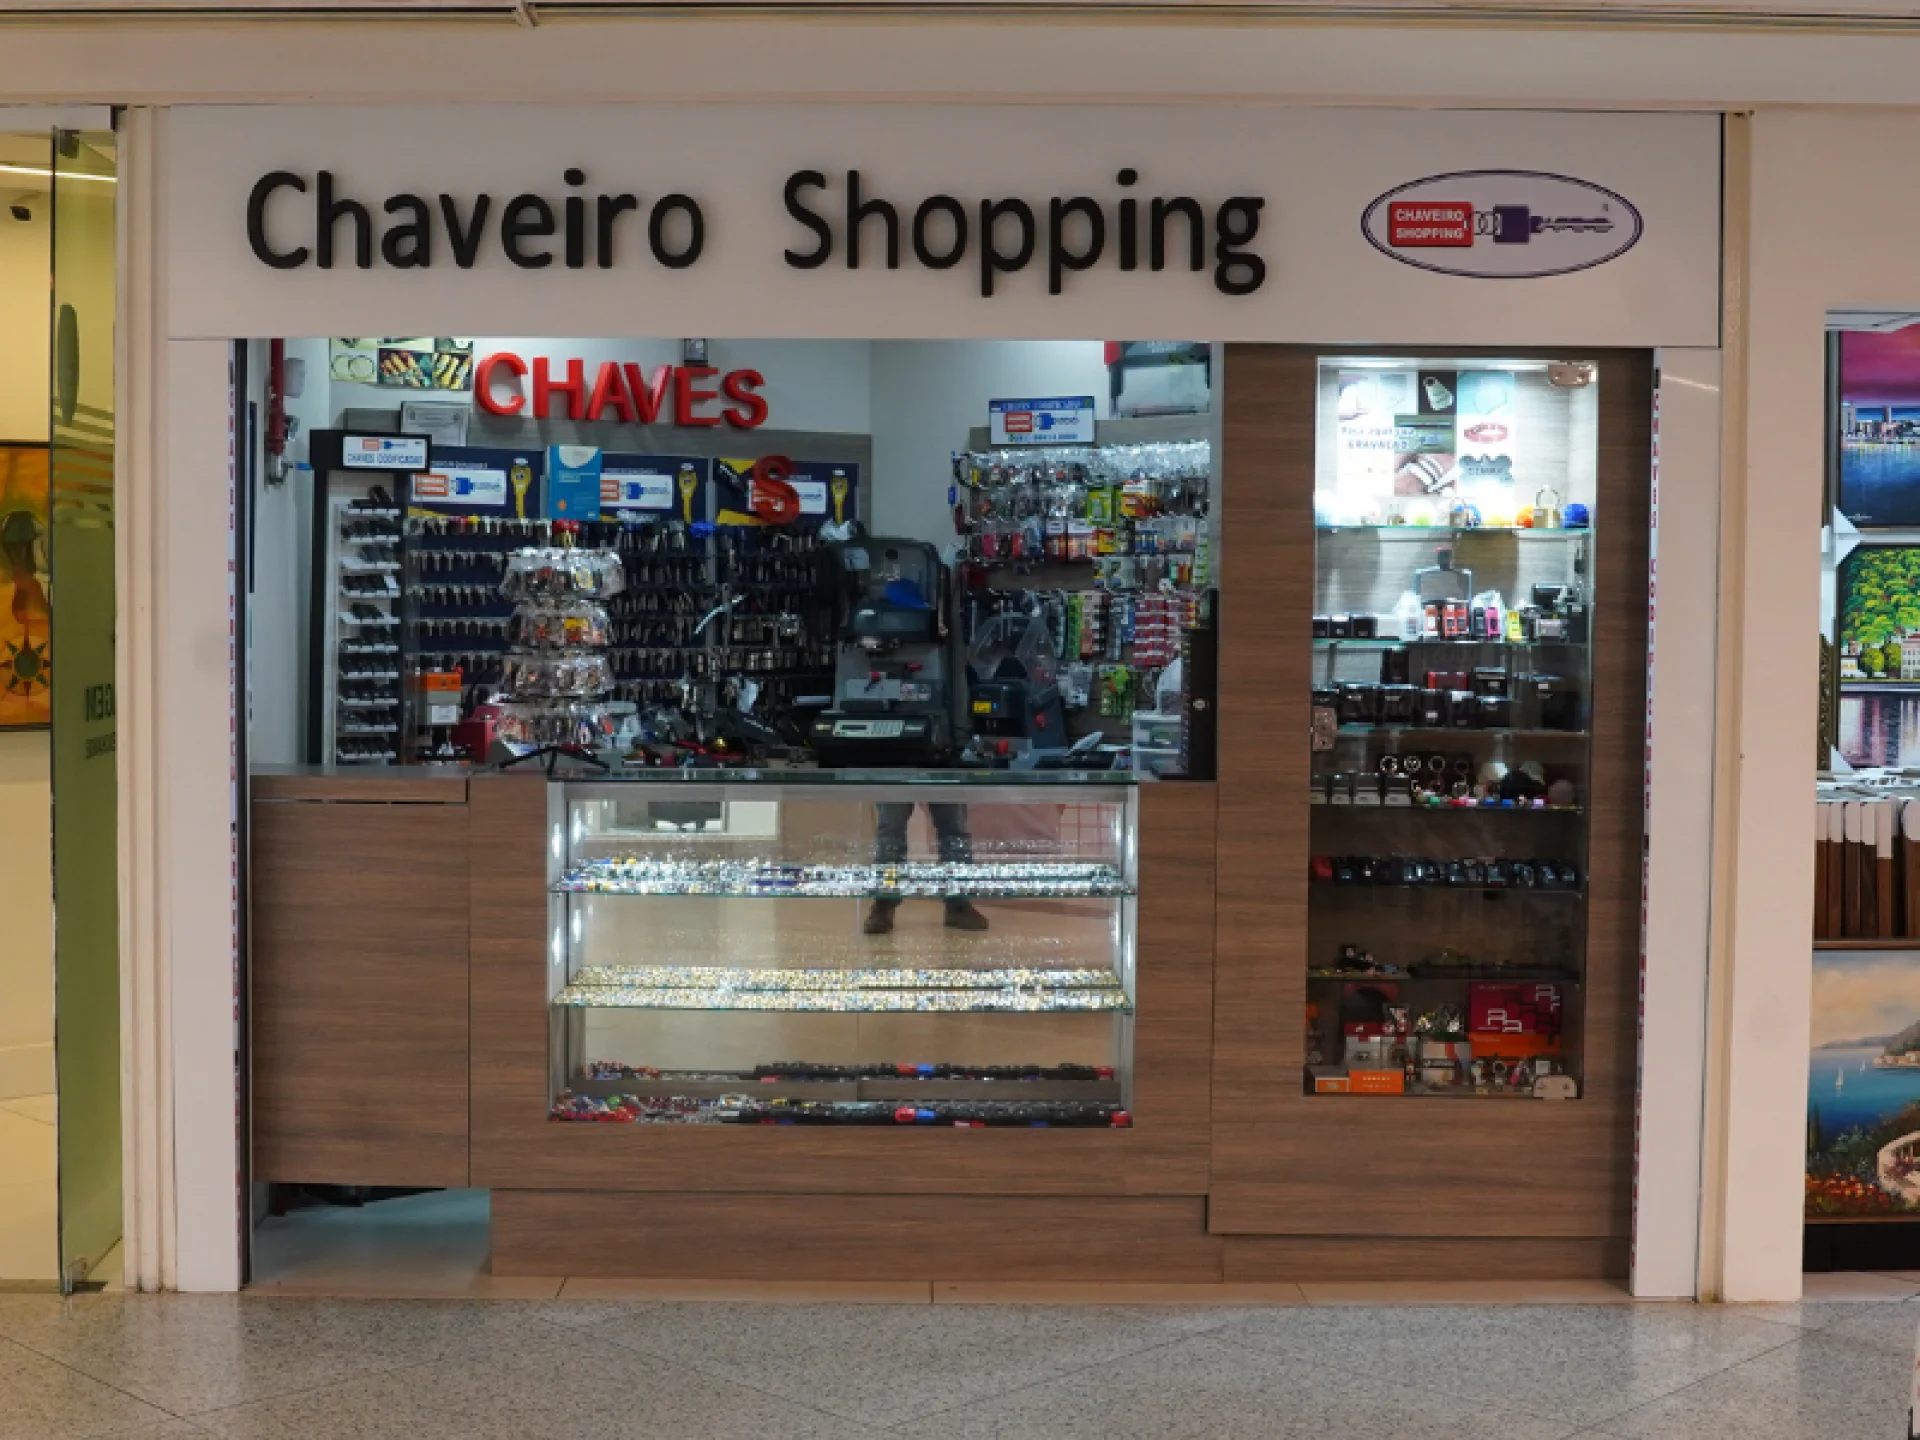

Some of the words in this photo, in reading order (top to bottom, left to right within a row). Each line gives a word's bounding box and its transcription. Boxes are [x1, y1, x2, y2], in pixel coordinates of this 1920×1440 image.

[247, 168, 704, 270] Chaveiro
[784, 168, 1266, 296] Shopping
[1395, 208, 1464, 222] CHAVEIRO
[1395, 227, 1464, 240] SHOPPING
[474, 352, 768, 428] CHAVES
